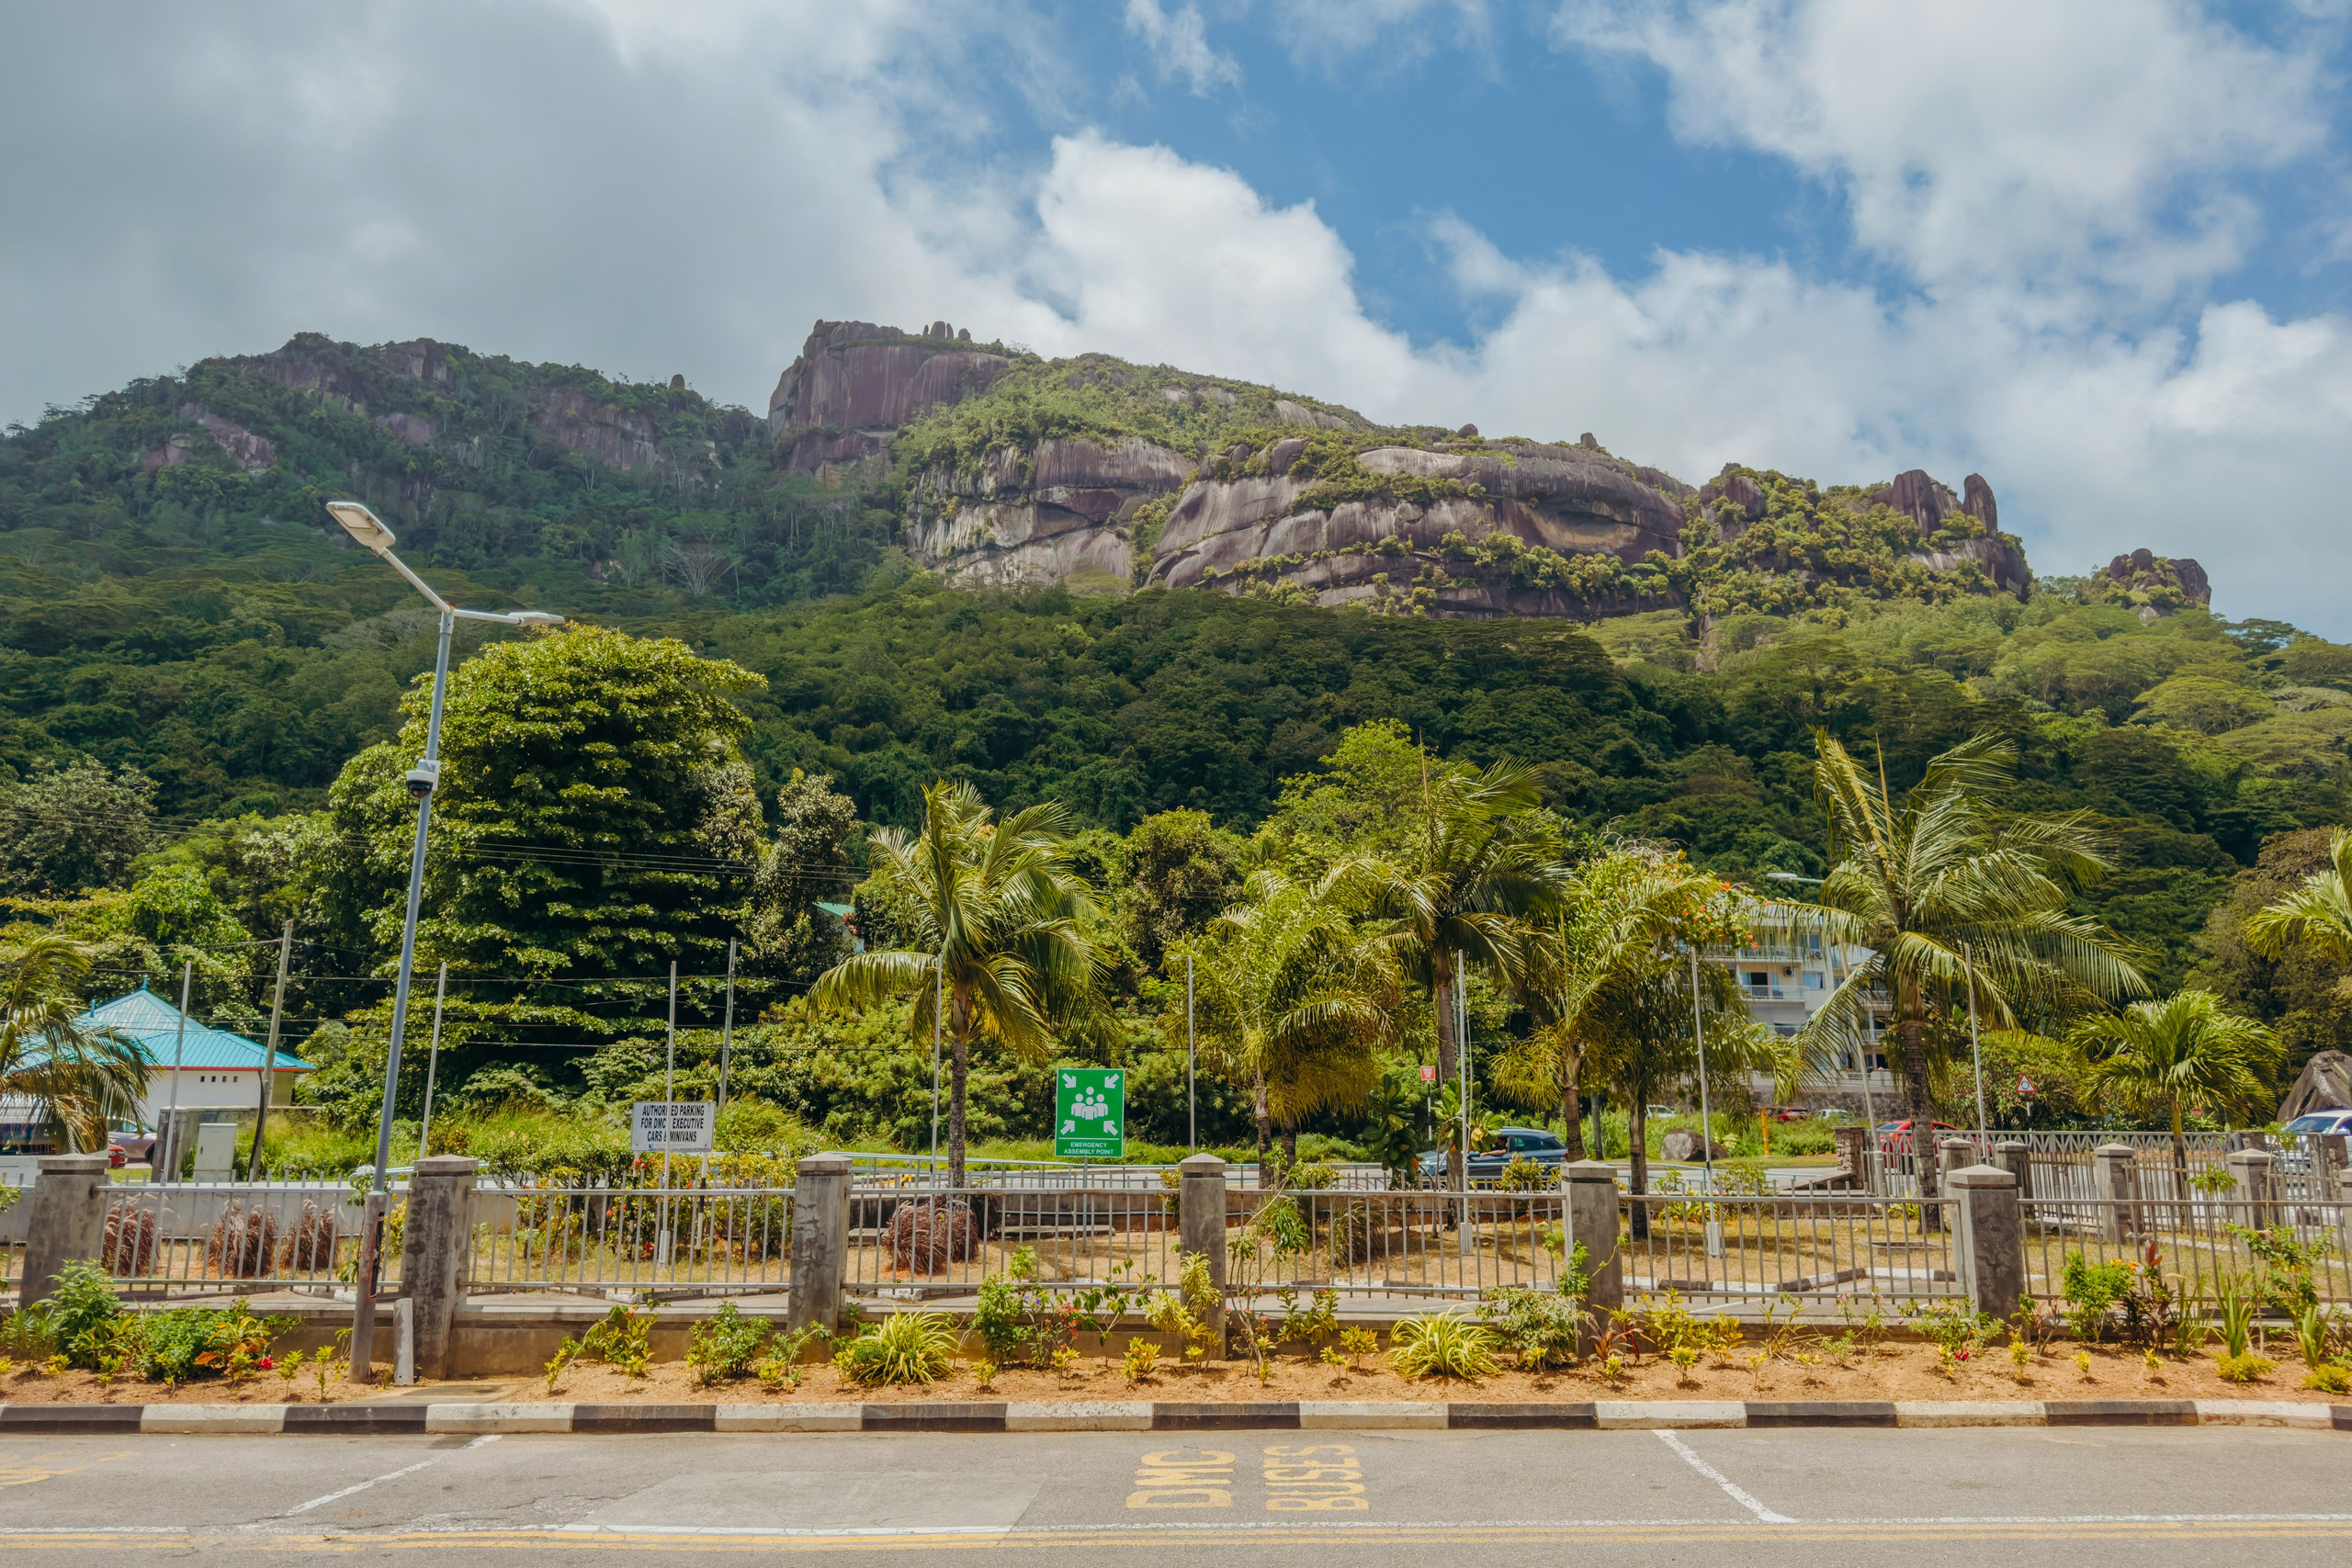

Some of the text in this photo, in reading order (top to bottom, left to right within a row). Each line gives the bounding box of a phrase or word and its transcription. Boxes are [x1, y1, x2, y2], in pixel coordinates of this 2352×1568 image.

[642, 1105, 705, 1116] AUTHORIED PARKING
[641, 1118, 652, 1129] FOR
[673, 1118, 704, 1129] EXECUTIVE
[647, 1131, 662, 1142] CARS
[670, 1131, 697, 1142] MINIVANS
[1125, 1450, 1236, 1508] DMC
[1263, 1445, 1370, 1510] BUSES
